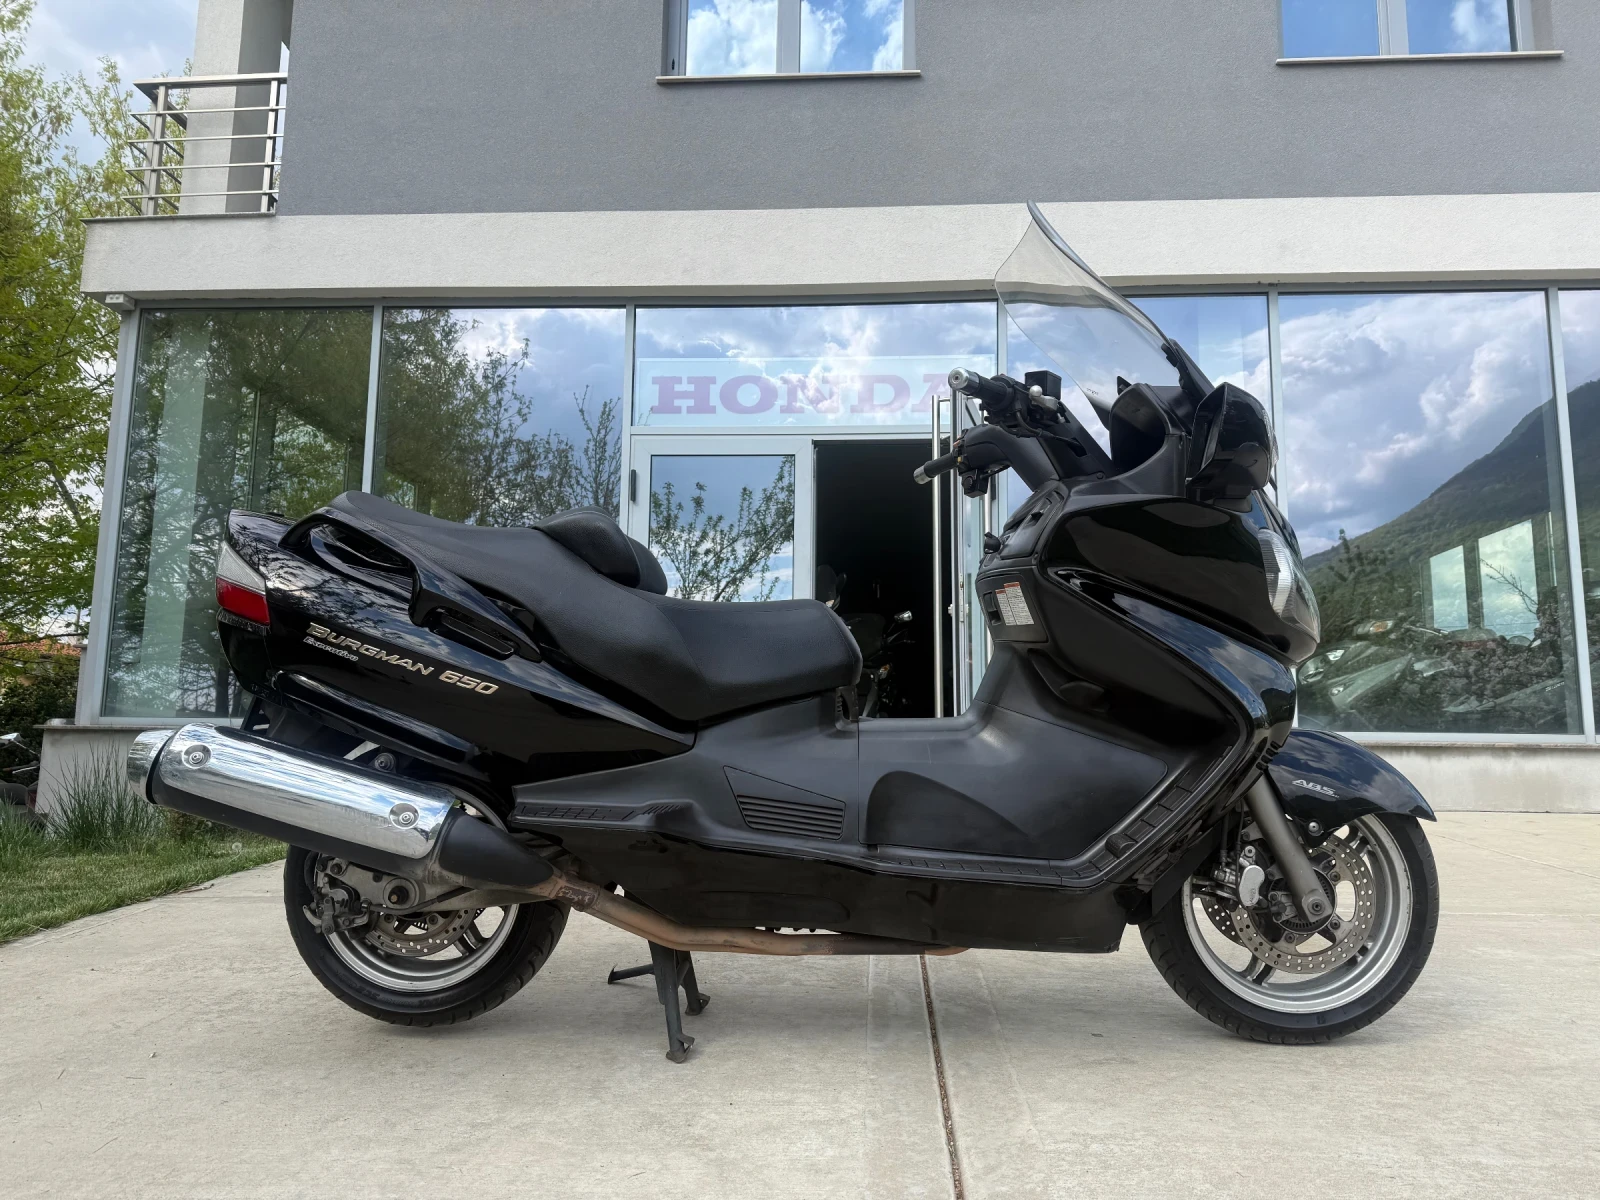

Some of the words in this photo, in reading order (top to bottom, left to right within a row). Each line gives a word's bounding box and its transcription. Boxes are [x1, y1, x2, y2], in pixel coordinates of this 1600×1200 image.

[306, 622, 434, 676] BURGMAN
[438, 670, 499, 695] 650
[1292, 779, 1337, 796] ABS
